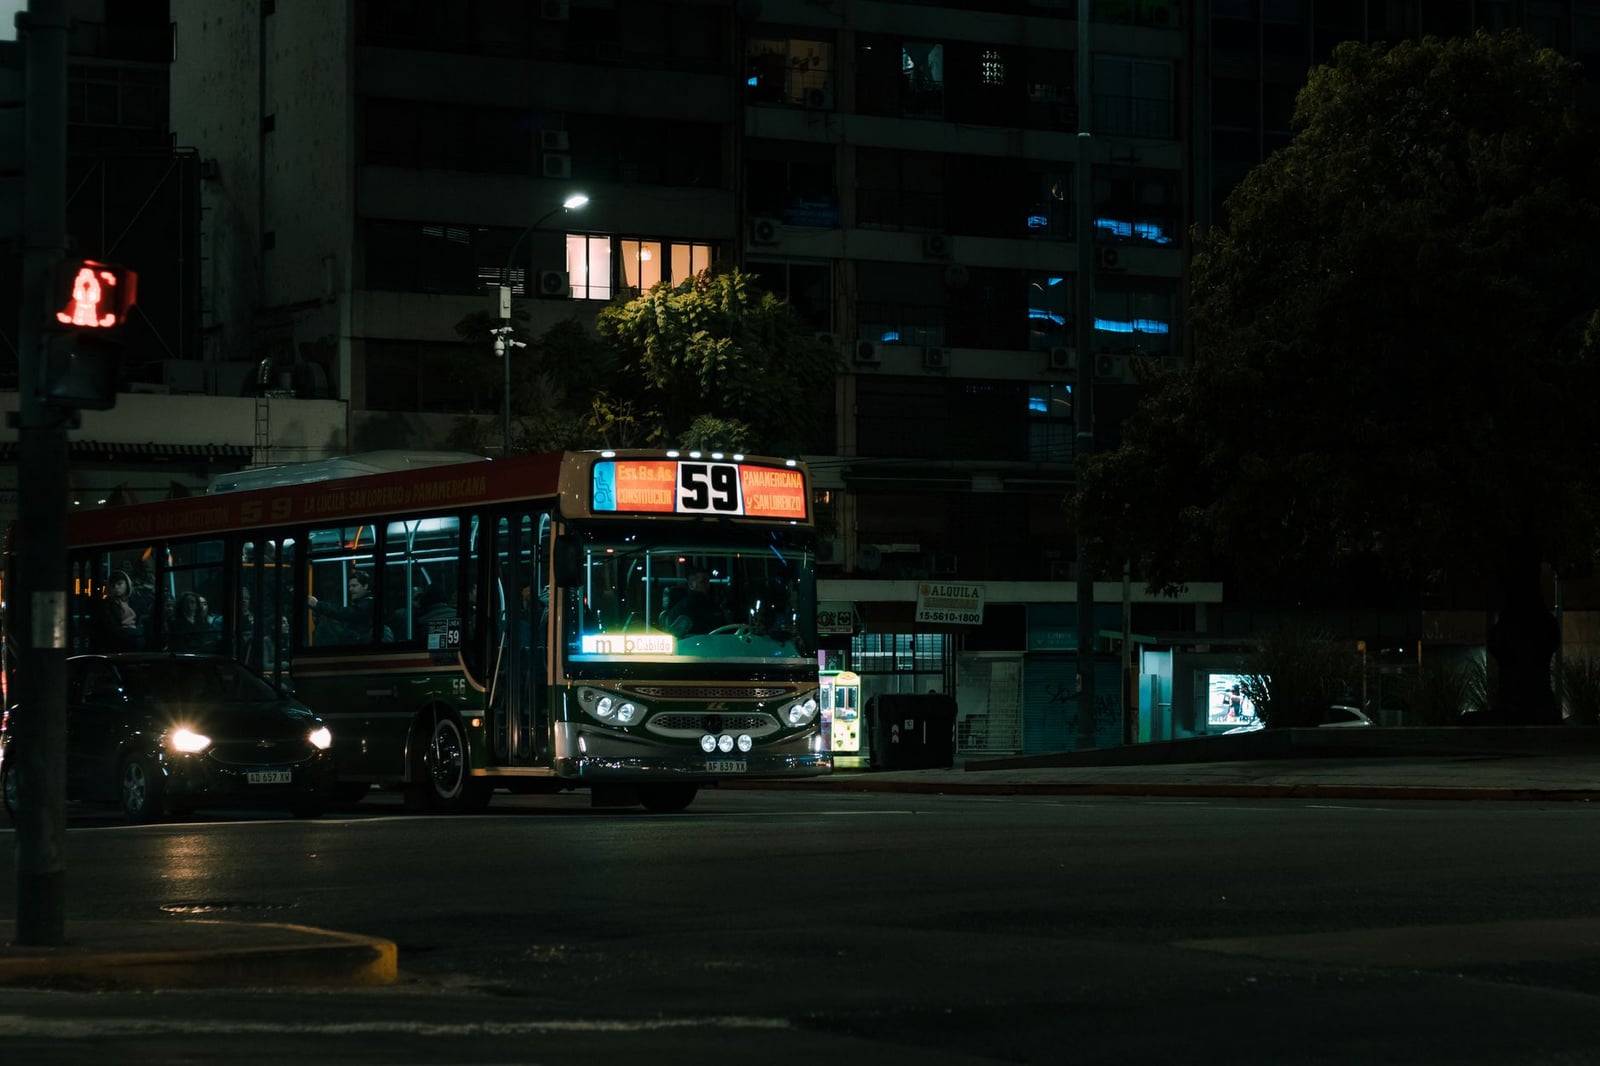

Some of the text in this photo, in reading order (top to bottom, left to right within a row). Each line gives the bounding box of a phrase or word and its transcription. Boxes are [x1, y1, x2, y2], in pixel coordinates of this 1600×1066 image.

[681, 463, 738, 512] 59
[743, 470, 802, 488] PANAMERICANA
[413, 477, 487, 502] PANAMERICANA
[241, 497, 292, 523] 59
[745, 494, 801, 511] y SAN LORENZO
[931, 585, 980, 598] ALQUILA
[919, 611, 980, 622] 15-5610-1800
[447, 629, 460, 644] 59
[262, 773, 277, 782] 657
